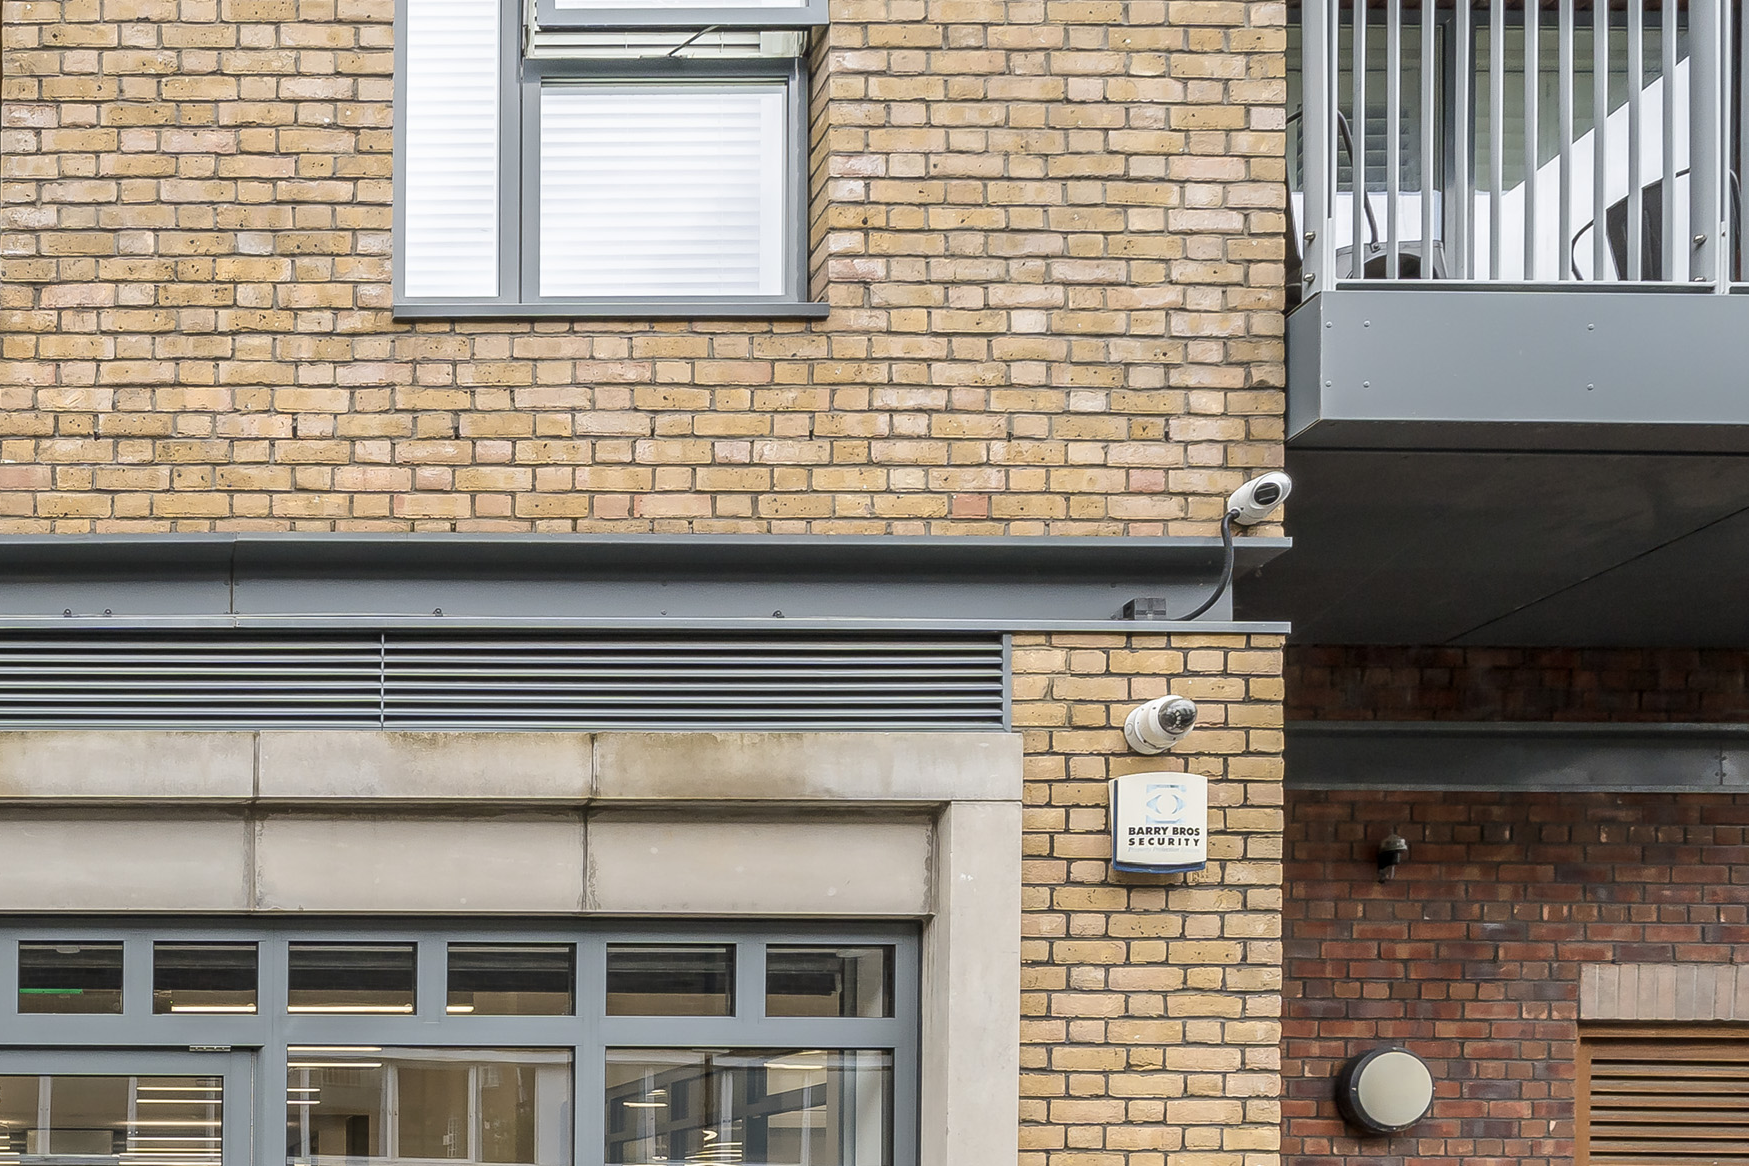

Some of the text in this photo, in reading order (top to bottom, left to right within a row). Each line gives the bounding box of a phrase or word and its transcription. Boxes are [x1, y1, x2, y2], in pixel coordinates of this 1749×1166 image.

[1128, 827, 1200, 836] BARRY BROS
[1128, 837, 1200, 847] SECURITY
